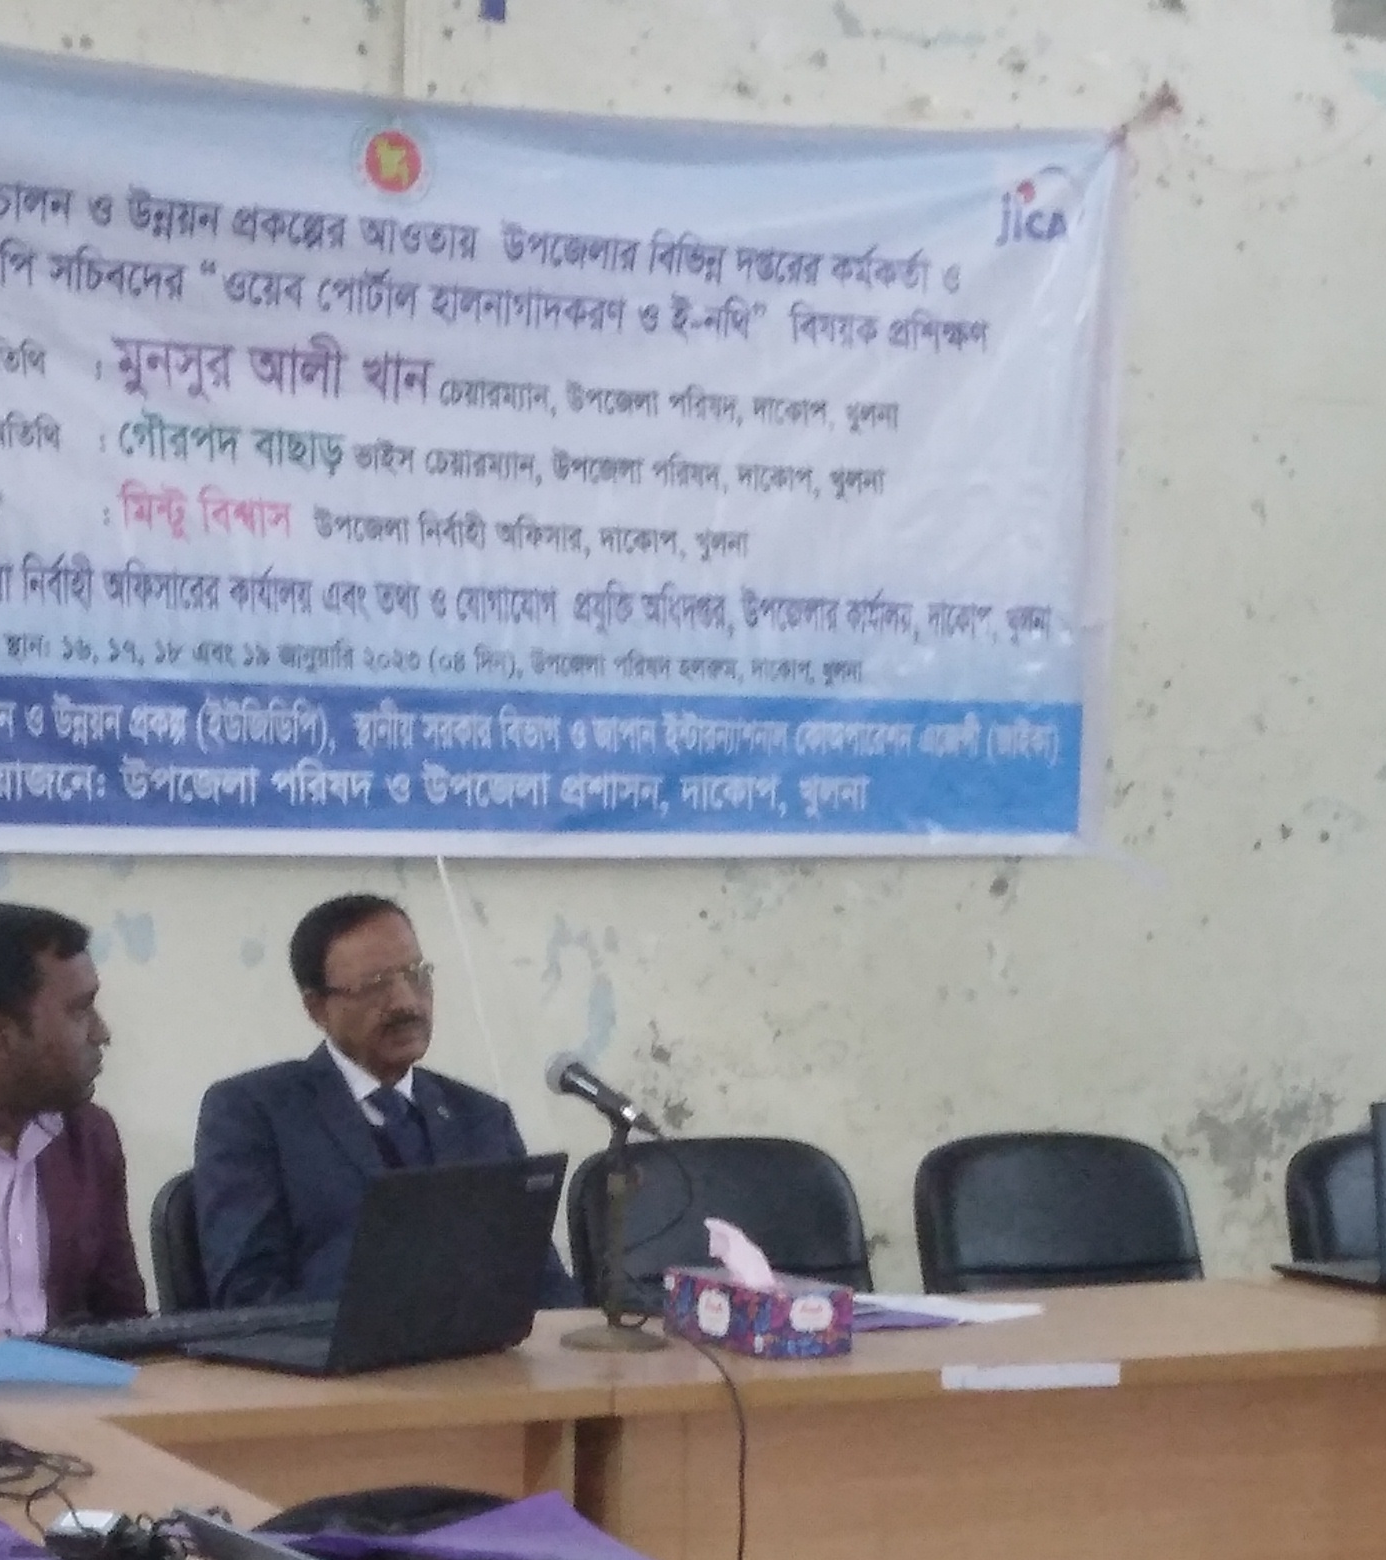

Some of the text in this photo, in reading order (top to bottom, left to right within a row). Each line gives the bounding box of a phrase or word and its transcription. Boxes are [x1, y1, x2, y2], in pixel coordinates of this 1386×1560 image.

[127, 183, 222, 243] উন্নয়ন
[232, 203, 347, 250] প্রকল্পের
[360, 215, 479, 259] আওতায়
[502, 218, 640, 270] উপজেলার
[648, 228, 726, 285] বিভিন্ন
[737, 246, 823, 286] দপ্তরের
[831, 244, 930, 292] কর্মকর্তা
[48, 245, 187, 299] সচিবদের
[318, 268, 419, 318] পোর্টাল
[430, 284, 626, 334] হালনাগাদকরণ
[790, 300, 879, 347] বিষয়ক
[888, 308, 988, 353] প্রশিক্ষণ
[112, 337, 235, 401] মুনসুর
[247, 332, 348, 398] আলী
[362, 350, 435, 404] খান
[566, 378, 658, 417] উপজেলা
[846, 400, 899, 435] খুলনা
[119, 407, 241, 466] গৌরপদ
[551, 445, 644, 484] উপজেলা
[829, 467, 885, 501] খুলনা
[197, 484, 291, 538] বিশ্বাস
[314, 503, 409, 544] উপজেলা
[418, 509, 486, 551] নির্বাহী
[695, 527, 748, 561] খুলনা
[21, 552, 93, 612] নির্বাহী
[103, 556, 219, 610] অফিসারের
[229, 563, 312, 614] কার্যালয়
[323, 582, 370, 622] এবং
[374, 582, 420, 619] তথ্য
[457, 582, 557, 626] যোগাযোগ
[573, 578, 634, 635] প্রযুক্তি
[741, 584, 840, 631] উপজেলার
[52, 690, 124, 749] উন্নয়ন
[422, 713, 492, 750] সরকার
[499, 703, 561, 751] বিভাগ
[119, 755, 259, 806] উপজেলা
[271, 756, 373, 808] পরিষদ
[421, 759, 551, 809] উপজেলা
[799, 774, 871, 820] খুলনা
